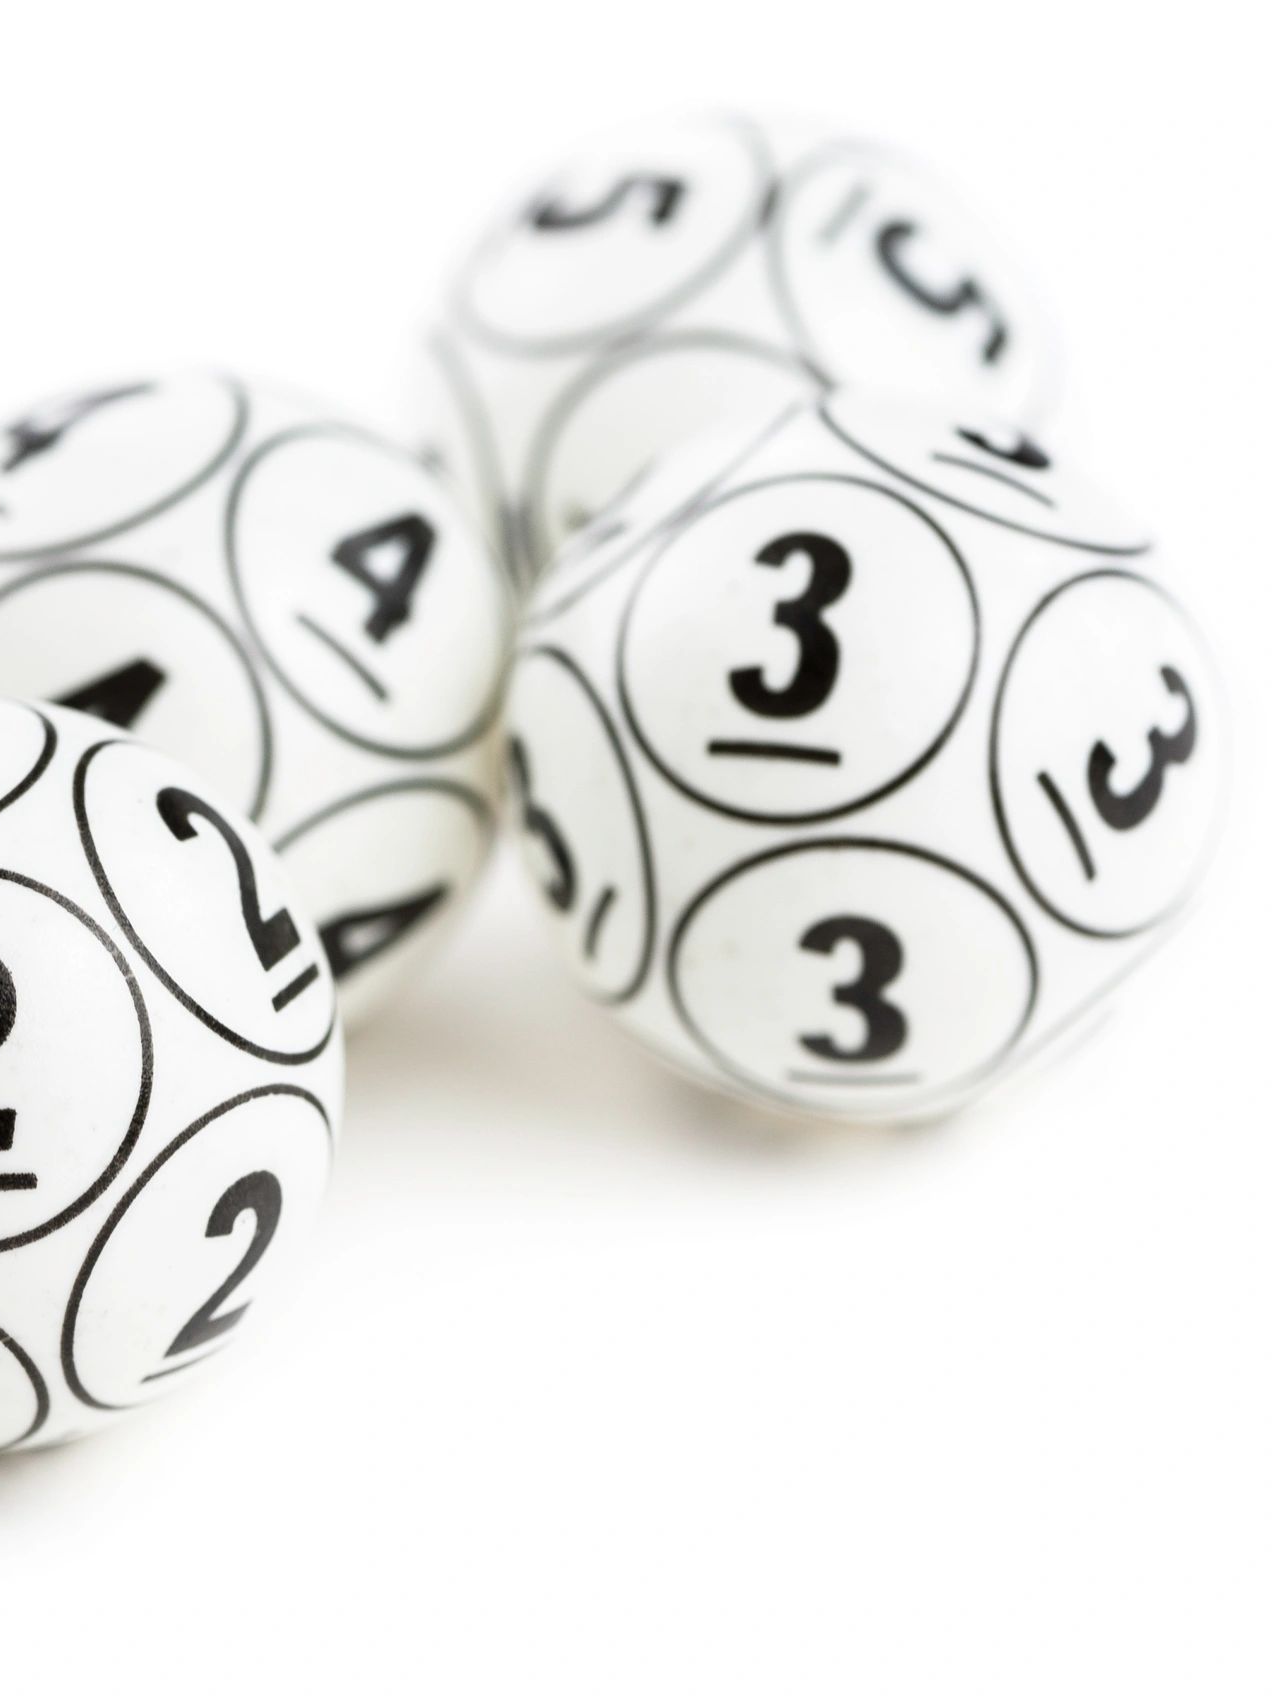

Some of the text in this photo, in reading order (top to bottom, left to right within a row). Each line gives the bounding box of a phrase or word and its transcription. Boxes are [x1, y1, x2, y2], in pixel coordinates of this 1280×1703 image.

[874, 218, 1009, 364] 5
[329, 510, 438, 645] 4
[727, 531, 853, 721] 3
[1086, 664, 1198, 832] 3
[156, 786, 302, 973] 2
[797, 913, 909, 1064] 3
[164, 1169, 283, 1358] 2
